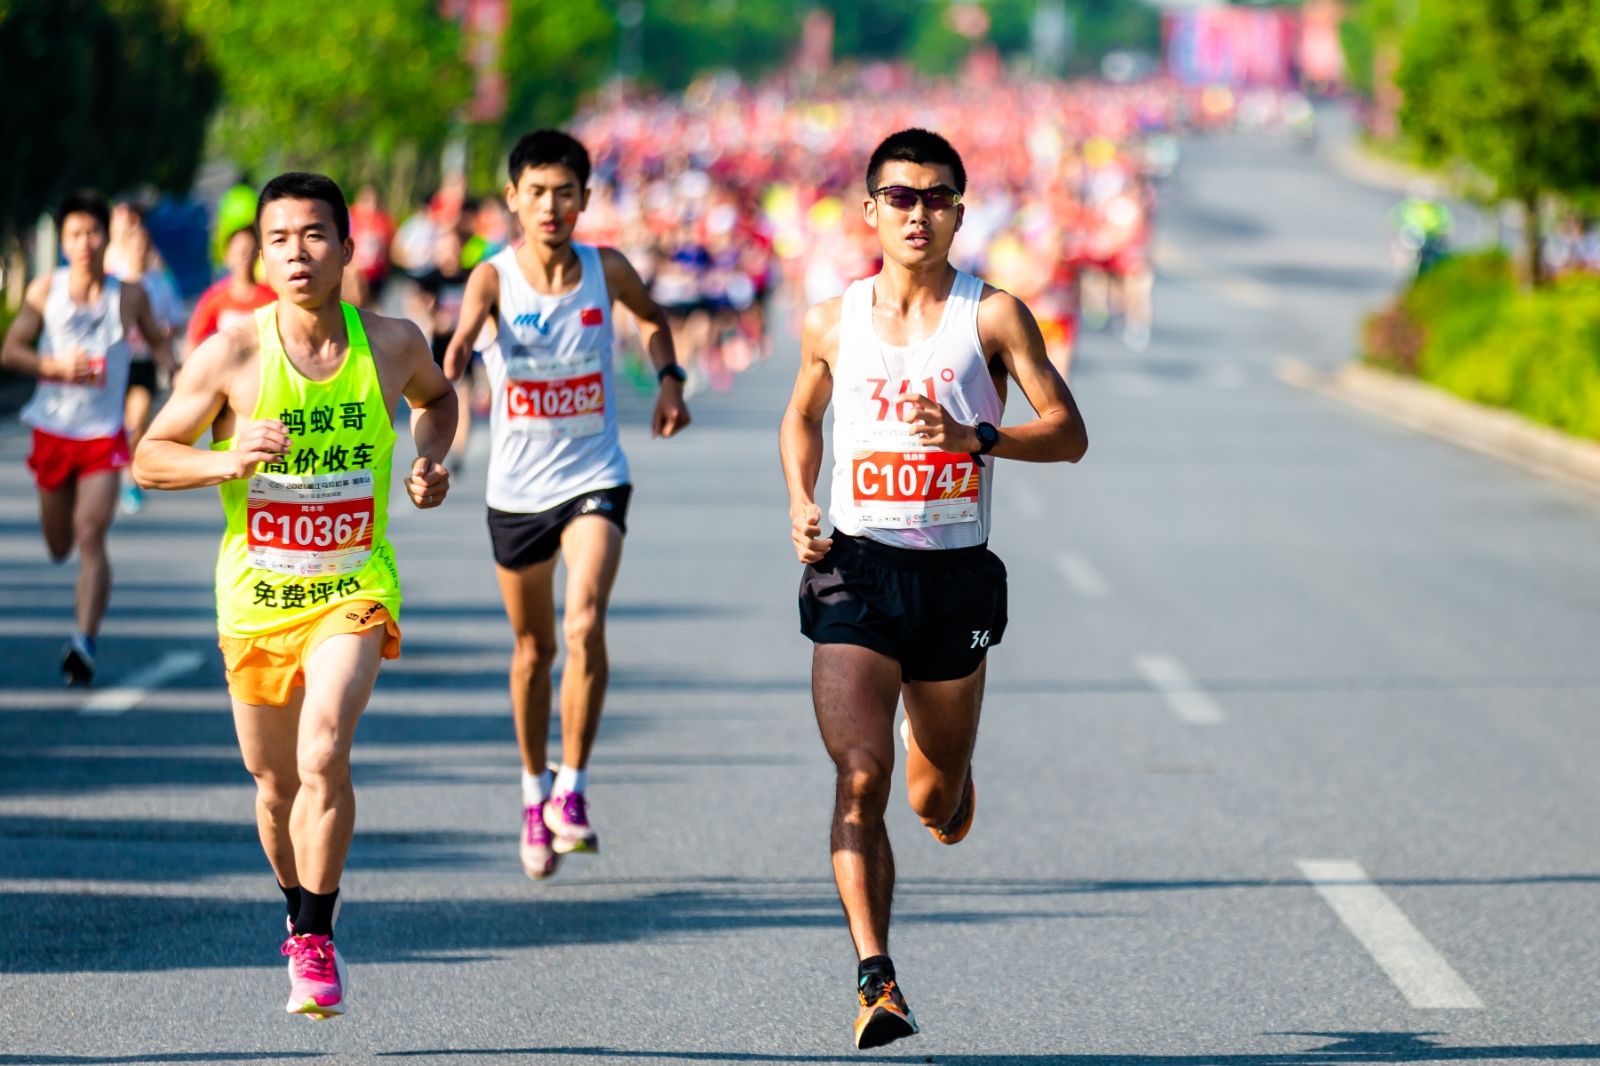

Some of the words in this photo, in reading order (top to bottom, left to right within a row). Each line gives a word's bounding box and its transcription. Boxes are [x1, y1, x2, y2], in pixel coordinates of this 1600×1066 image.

[509, 382, 601, 416] C10262
[279, 401, 367, 437] 蚂蚁哥
[856, 461, 974, 497] C10747
[251, 510, 370, 547] C10367
[253, 576, 361, 609] 免费评估
